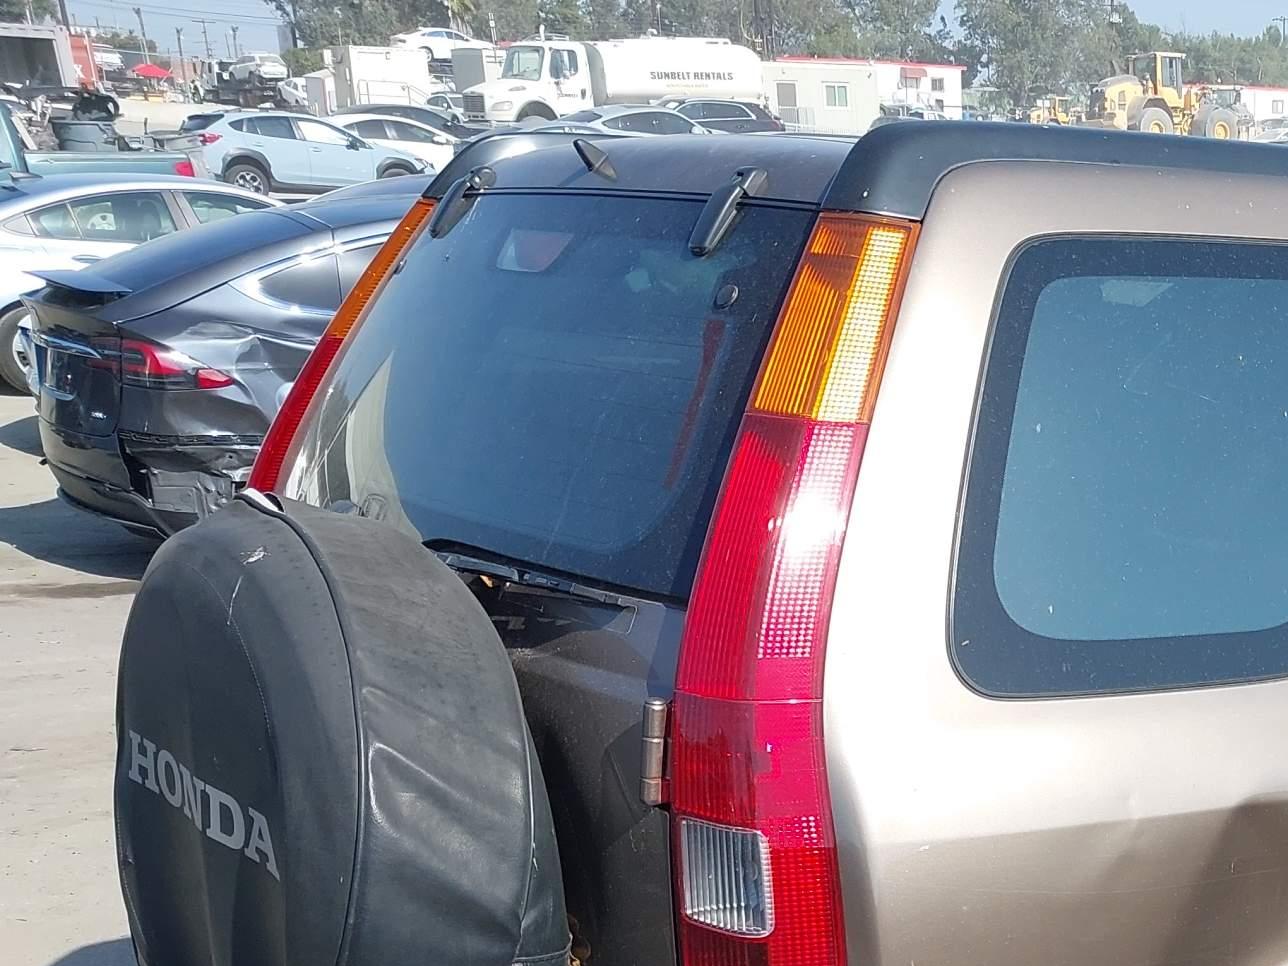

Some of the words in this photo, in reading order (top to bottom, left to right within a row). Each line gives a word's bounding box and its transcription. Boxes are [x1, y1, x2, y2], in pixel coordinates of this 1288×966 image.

[649, 71, 691, 81] SUNBELT
[693, 71, 735, 81] RENTALS
[128, 729, 281, 882] HONDA
